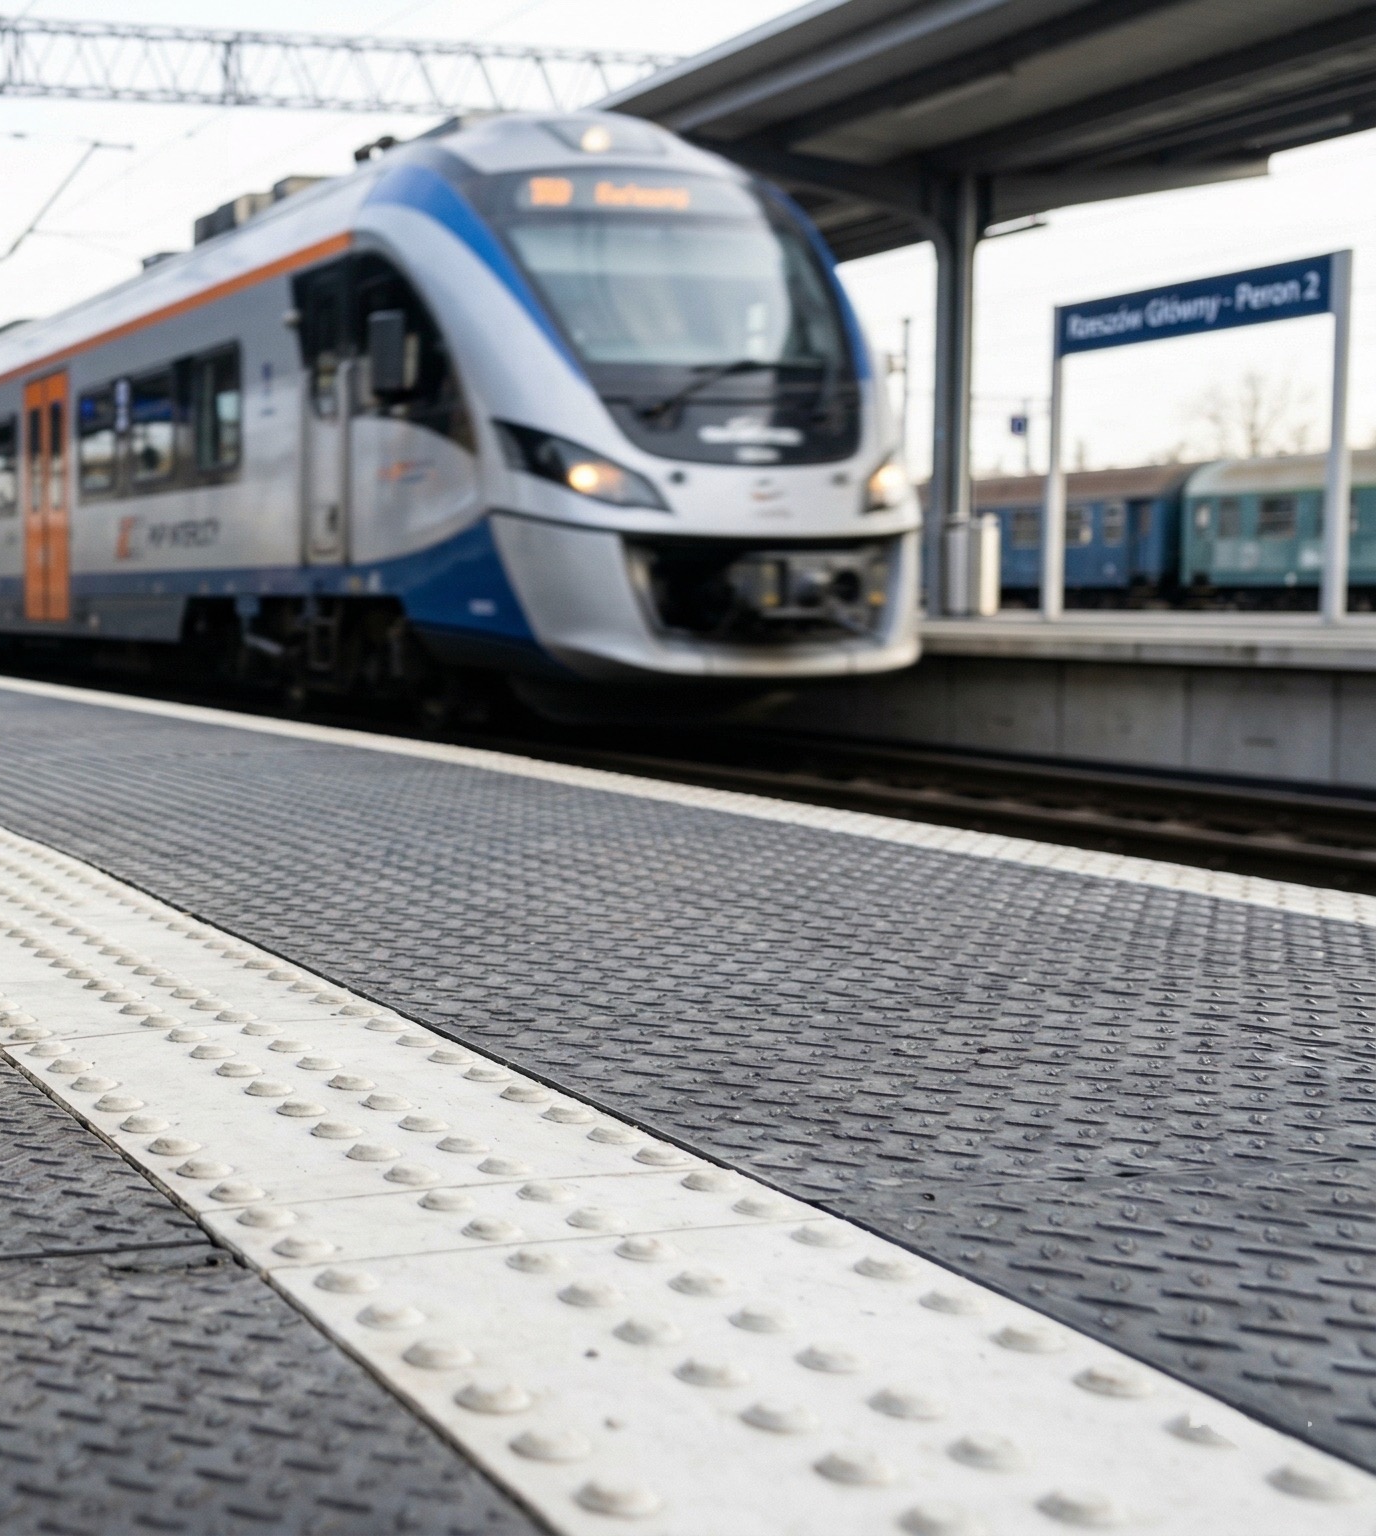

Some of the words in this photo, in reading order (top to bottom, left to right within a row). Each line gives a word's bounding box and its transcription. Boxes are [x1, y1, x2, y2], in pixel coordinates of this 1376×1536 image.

[1066, 304, 1143, 340] Rzeszów
[1144, 293, 1222, 326] Główny
[1234, 280, 1301, 311] Peron
[1303, 270, 1321, 301] 2
